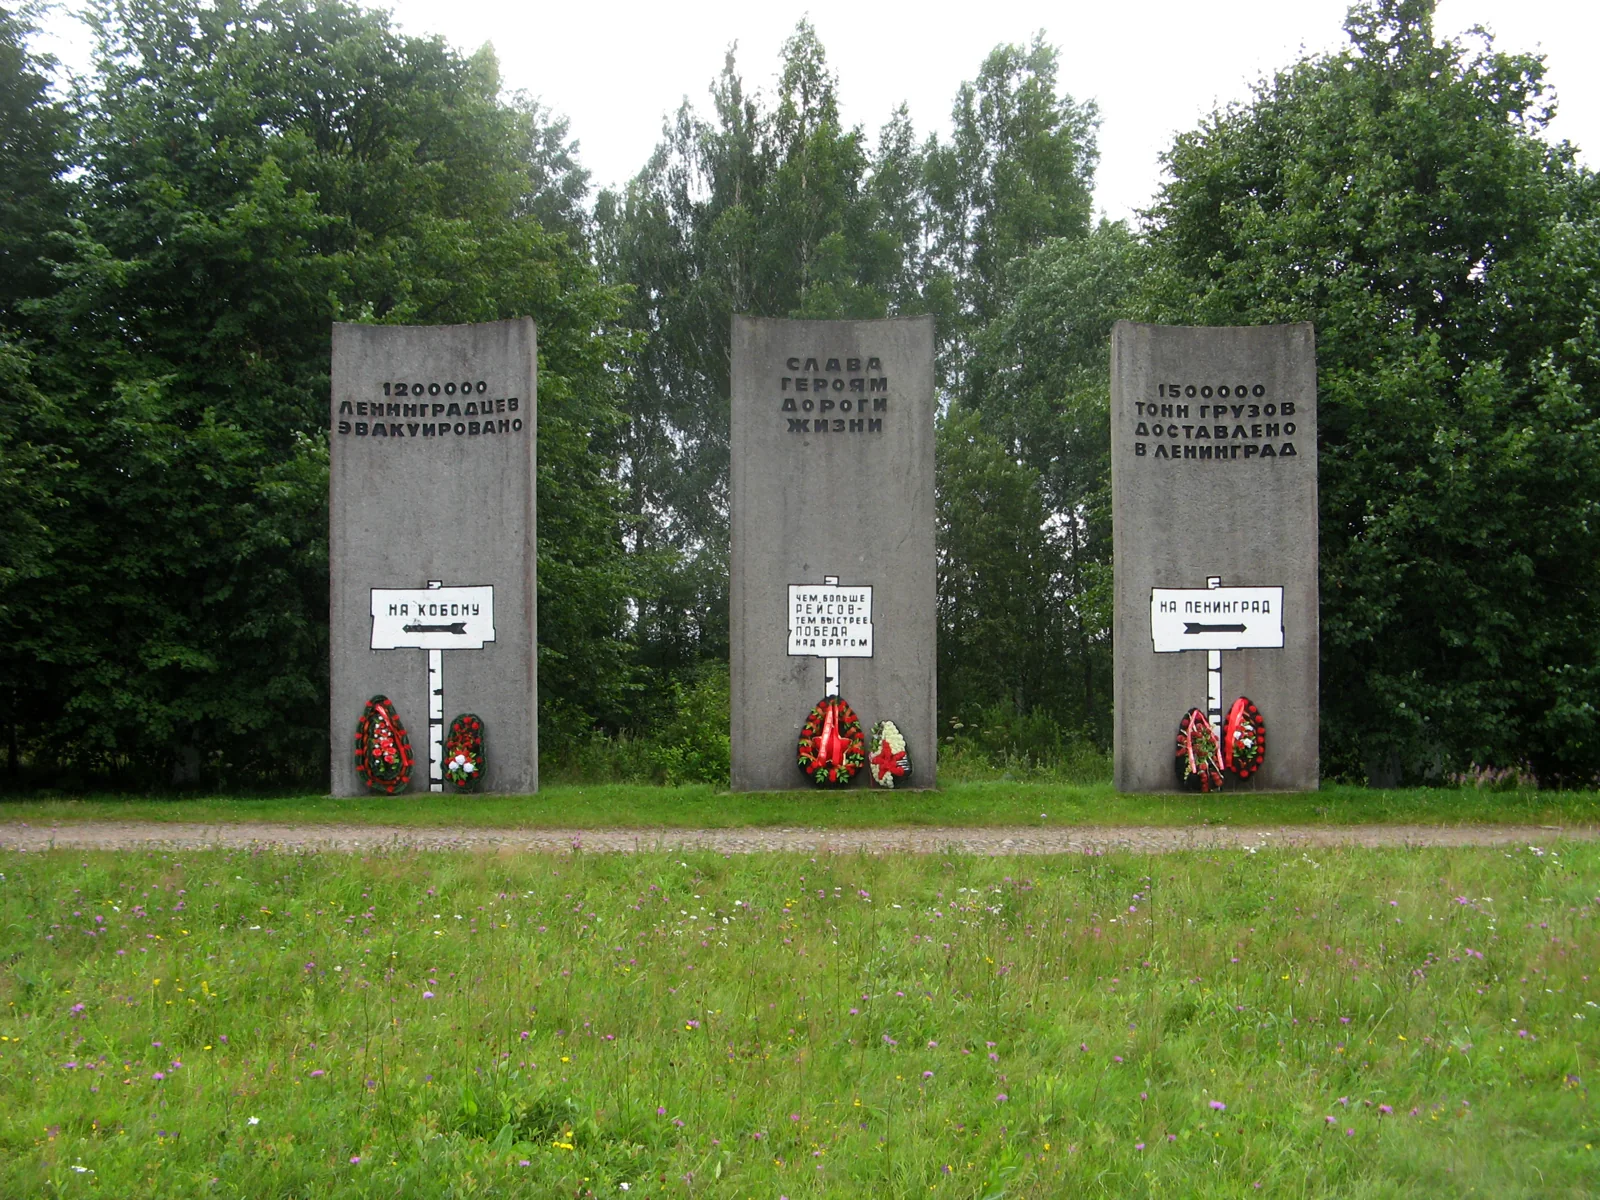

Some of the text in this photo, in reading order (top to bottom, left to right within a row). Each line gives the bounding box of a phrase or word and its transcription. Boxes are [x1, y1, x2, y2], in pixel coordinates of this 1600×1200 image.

[786, 357, 882, 373] СЛАВА
[781, 377, 888, 392] ГЕРОЯМ
[338, 397, 520, 418] ЛЕНИНГРАДЦЕВ
[781, 398, 888, 413] ДОРОГИ
[1135, 401, 1296, 419] ТОНН ГРУЗОВ
[338, 418, 523, 437] ЭВАКУИРОВАНО
[786, 418, 882, 433] ЖИЗНИ
[1135, 422, 1297, 439] ДОСТАВЛЕНО
[1135, 442, 1298, 460] В ЛЕНИНГРАД
[796, 594, 818, 602] ЧЕМ
[388, 604, 480, 616] НА КОБОНУ
[1160, 600, 1177, 613] НА
[796, 616, 868, 624] ТЕМ БЫСТРЕЕ
[796, 626, 848, 637] ПОБЕДА
[795, 638, 868, 647] НАД ВРАГОМ
